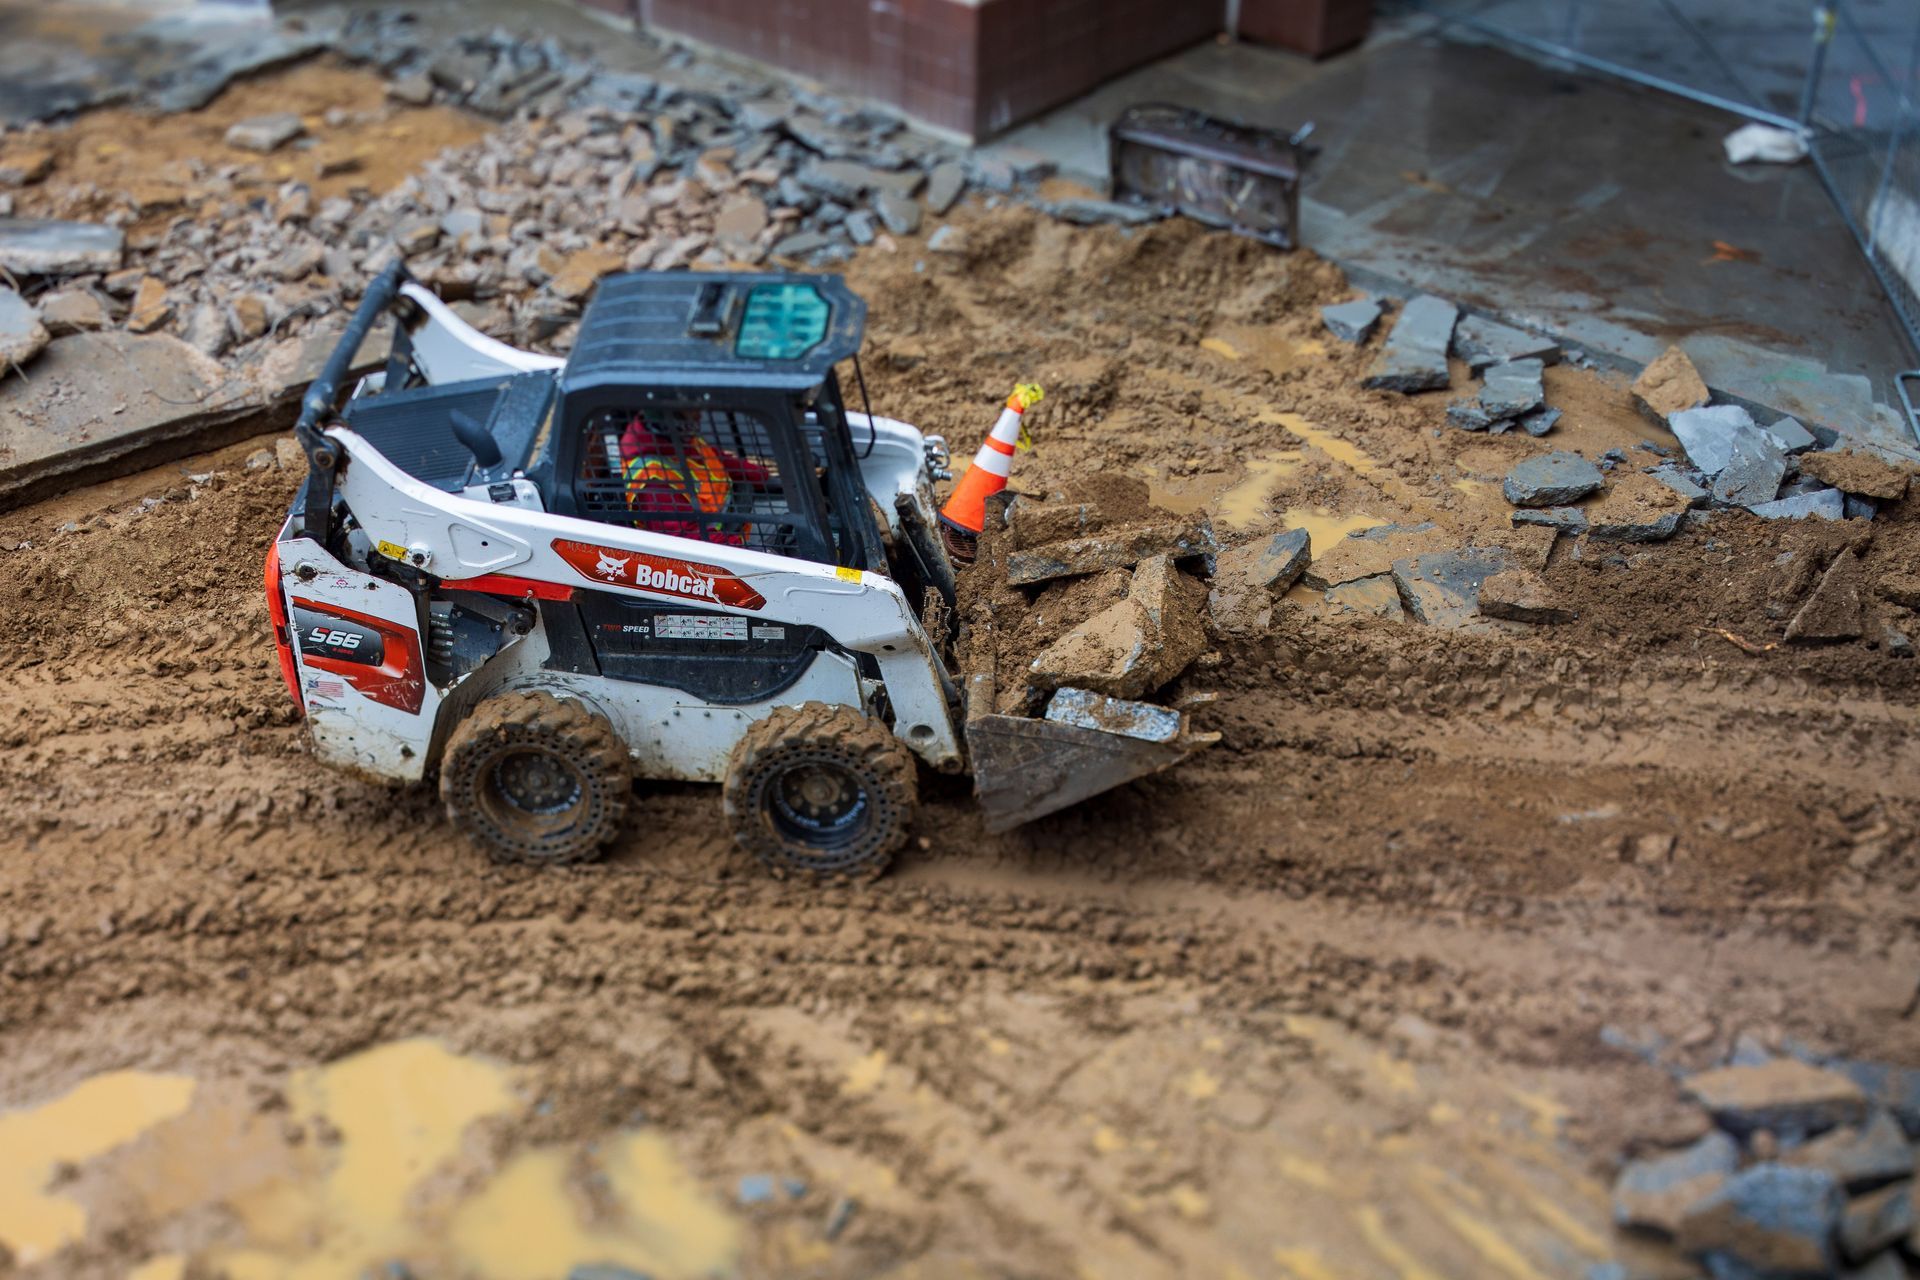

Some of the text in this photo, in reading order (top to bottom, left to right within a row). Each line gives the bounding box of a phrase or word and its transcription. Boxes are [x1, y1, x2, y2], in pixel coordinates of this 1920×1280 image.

[636, 564, 716, 598] Bobcat
[308, 627, 364, 649] S66
[622, 625, 650, 633] SPEED
